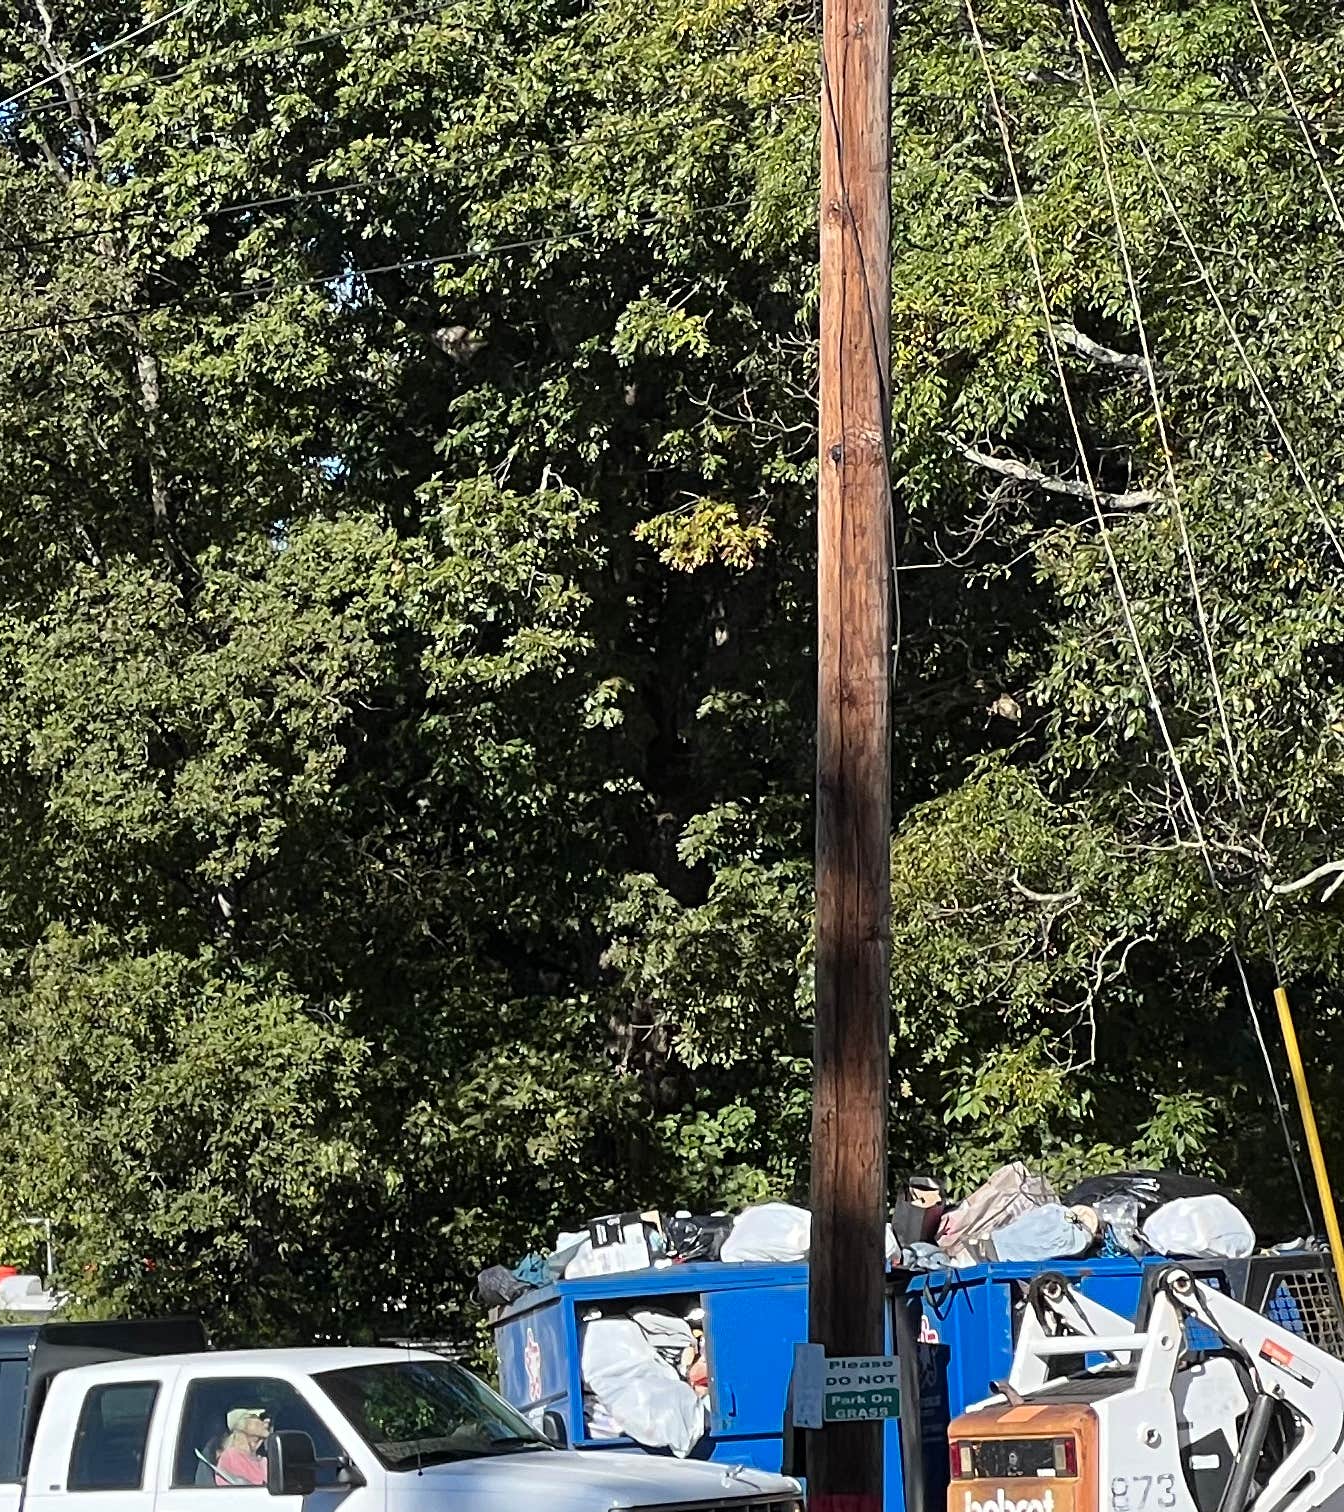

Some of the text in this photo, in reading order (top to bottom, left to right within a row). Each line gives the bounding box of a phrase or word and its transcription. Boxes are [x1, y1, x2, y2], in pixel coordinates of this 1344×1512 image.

[829, 1360, 894, 1370] Please
[826, 1374, 897, 1386] DO NOT
[831, 1393, 893, 1406] Park On
[835, 1407, 889, 1419] GRASS
[1111, 1473, 1177, 1512] 873
